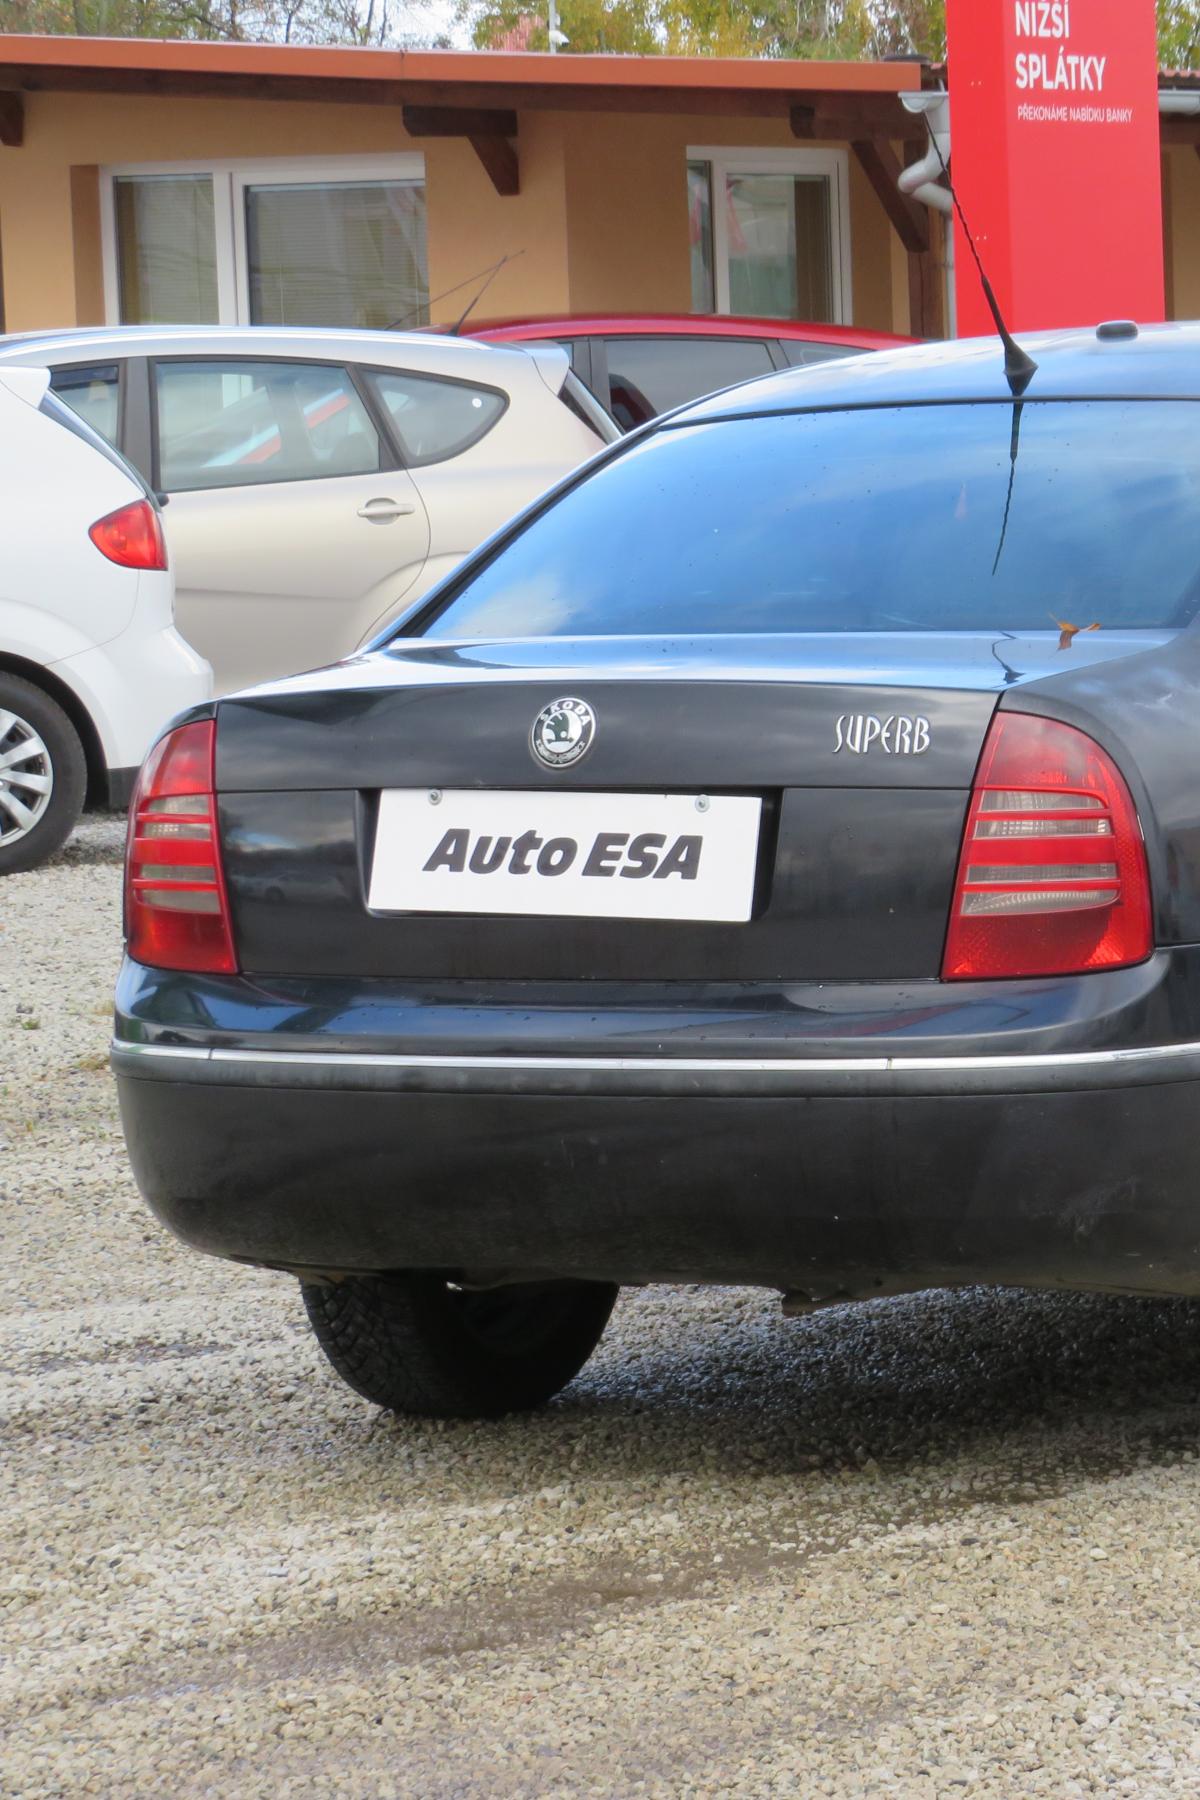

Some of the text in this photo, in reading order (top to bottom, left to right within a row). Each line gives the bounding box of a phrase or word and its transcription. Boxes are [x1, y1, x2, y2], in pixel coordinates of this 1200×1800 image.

[1015, 45, 1106, 91] SPLÁTKY
[1017, 102, 1132, 123] PŘEKONÁME NABÍDKU BANKY
[832, 714, 931, 755] SUPERB
[422, 828, 703, 880] Auto ESA
